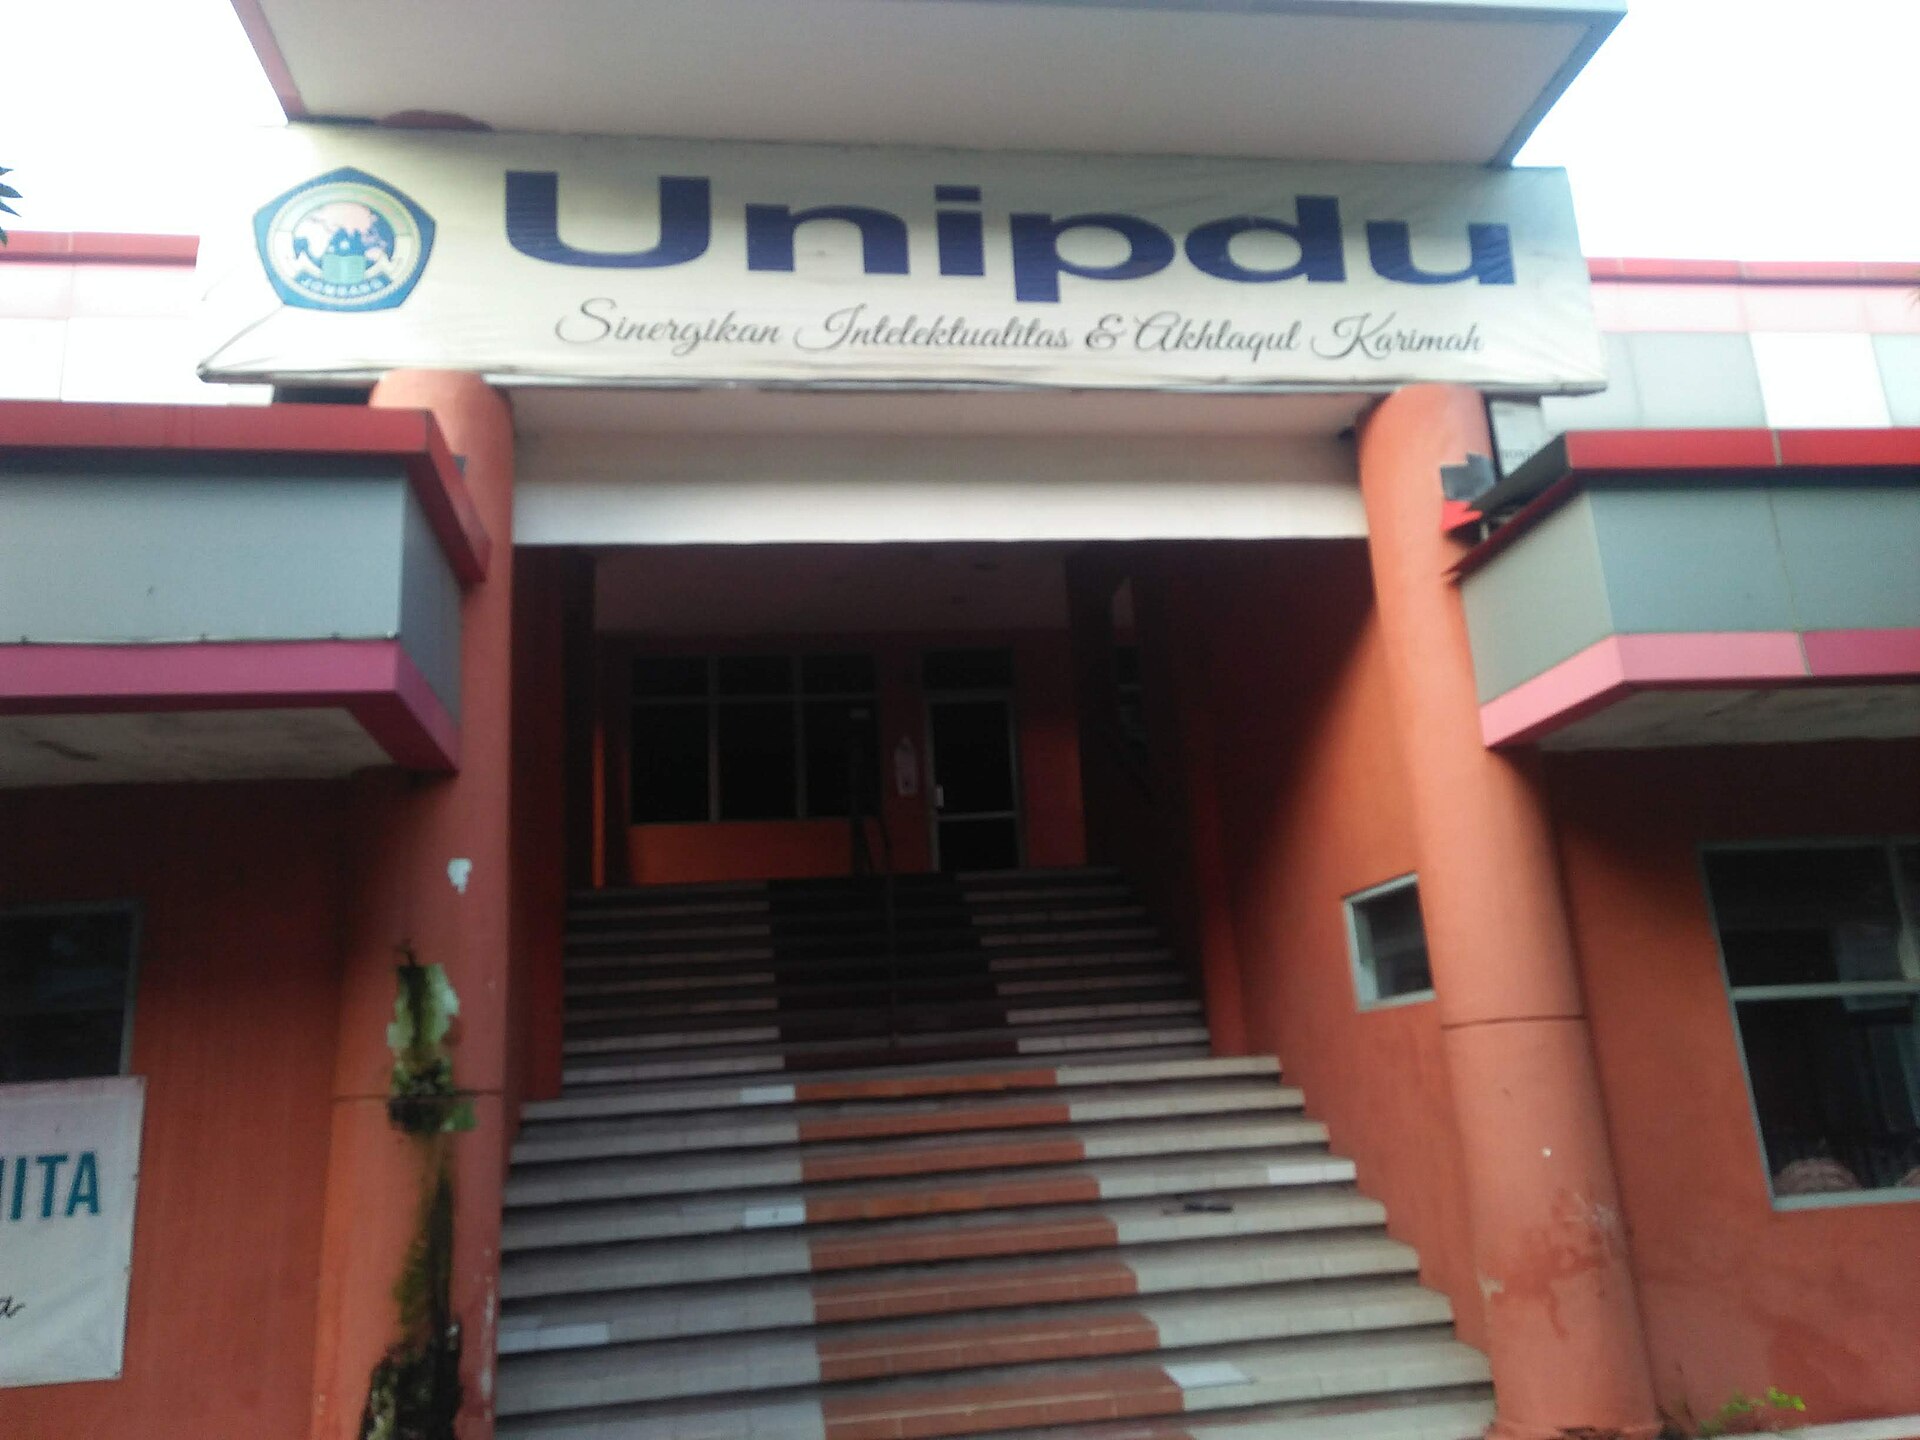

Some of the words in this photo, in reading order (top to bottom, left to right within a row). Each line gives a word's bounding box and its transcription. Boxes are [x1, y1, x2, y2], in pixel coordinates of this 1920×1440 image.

[506, 170, 1515, 303] Unipdu
[554, 296, 782, 357] Sinergikan
[793, 302, 1069, 351] Intelektualitas
[1085, 313, 1126, 350] &
[1134, 310, 1302, 363] Akhlaqul
[1310, 311, 1483, 360] Karimah
[0, 1151, 99, 1221] ITA
